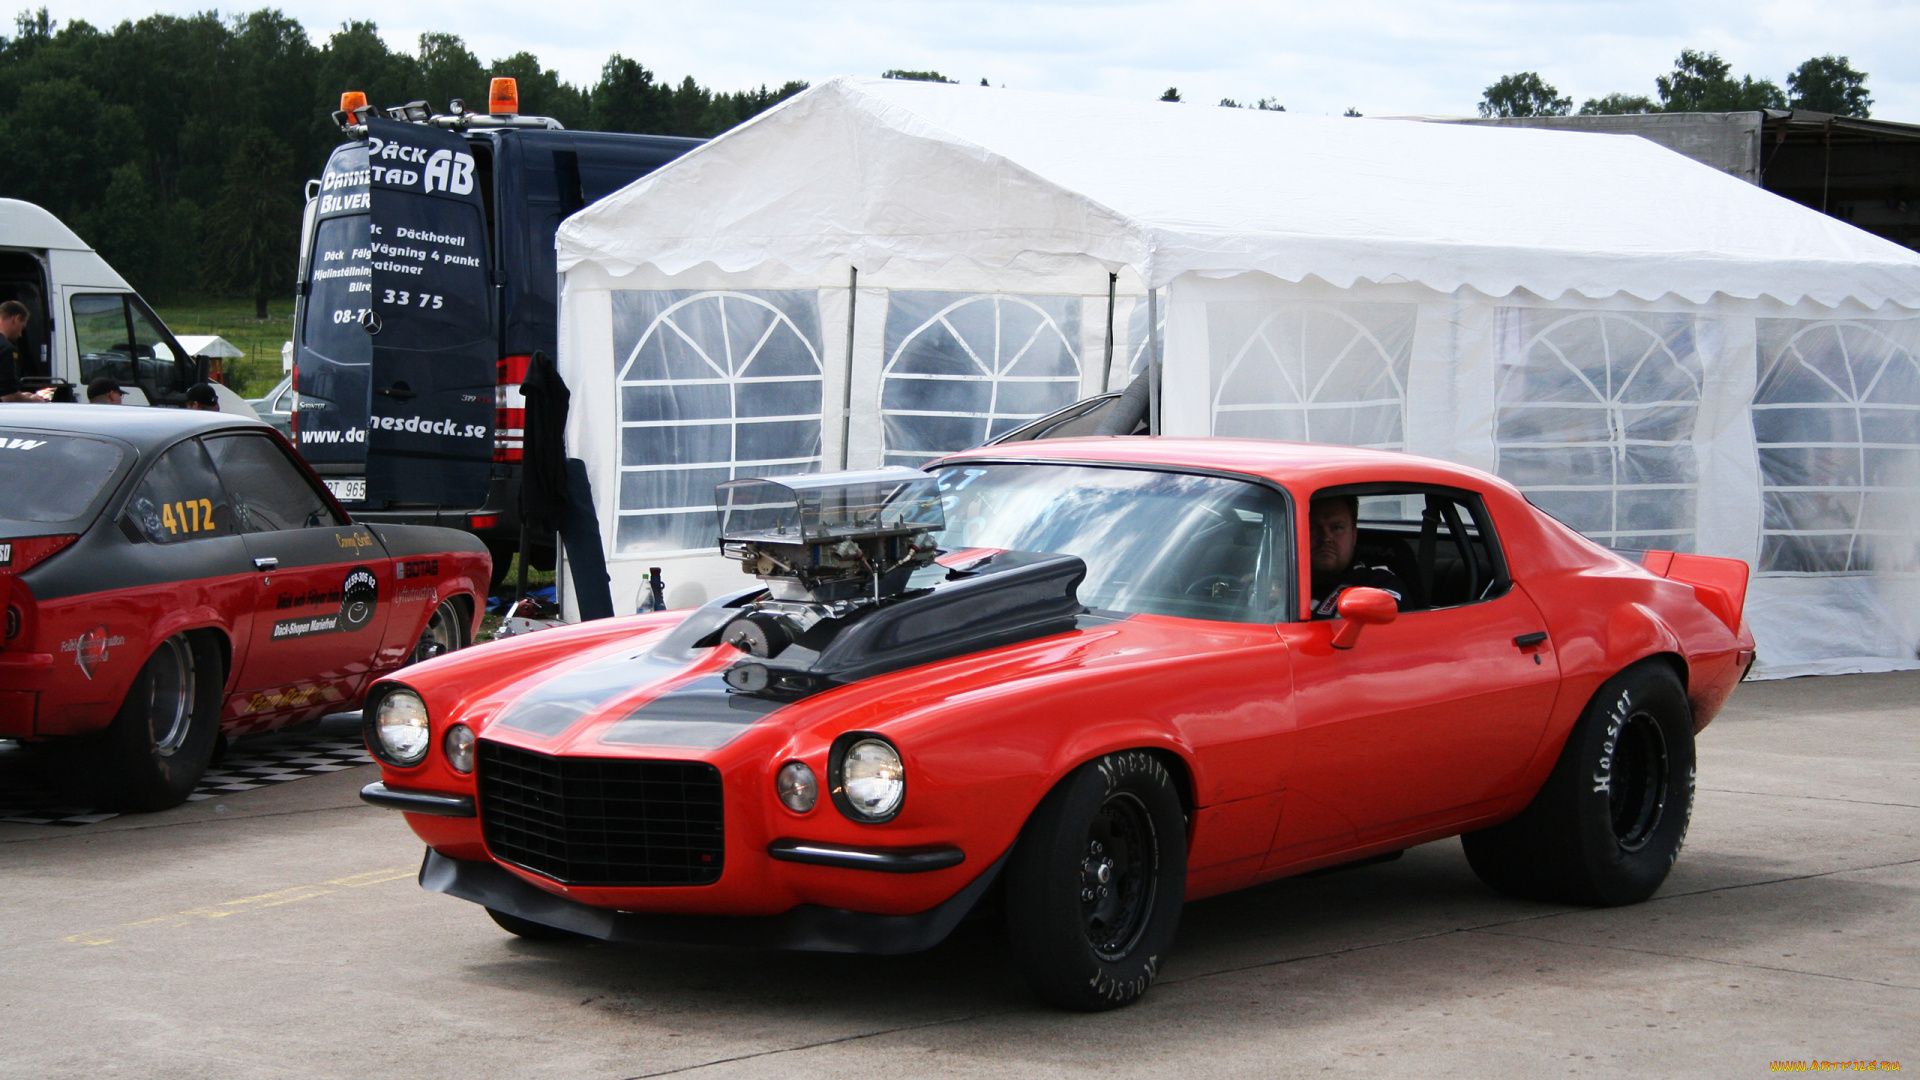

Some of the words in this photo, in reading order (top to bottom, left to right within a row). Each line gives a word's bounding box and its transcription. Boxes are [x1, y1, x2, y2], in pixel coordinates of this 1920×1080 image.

[424, 149, 475, 196] AB
[396, 227, 466, 247] Däckhotell
[324, 250, 345, 262] Däck
[371, 242, 427, 261] Vägning
[430, 250, 441, 261] 4
[443, 254, 481, 268] punkt
[348, 282, 372, 293] Bilre
[419, 293, 444, 310] 75
[346, 482, 367, 497] 965
[162, 498, 216, 536] 4172
[1593, 689, 1631, 797] Hoosier
